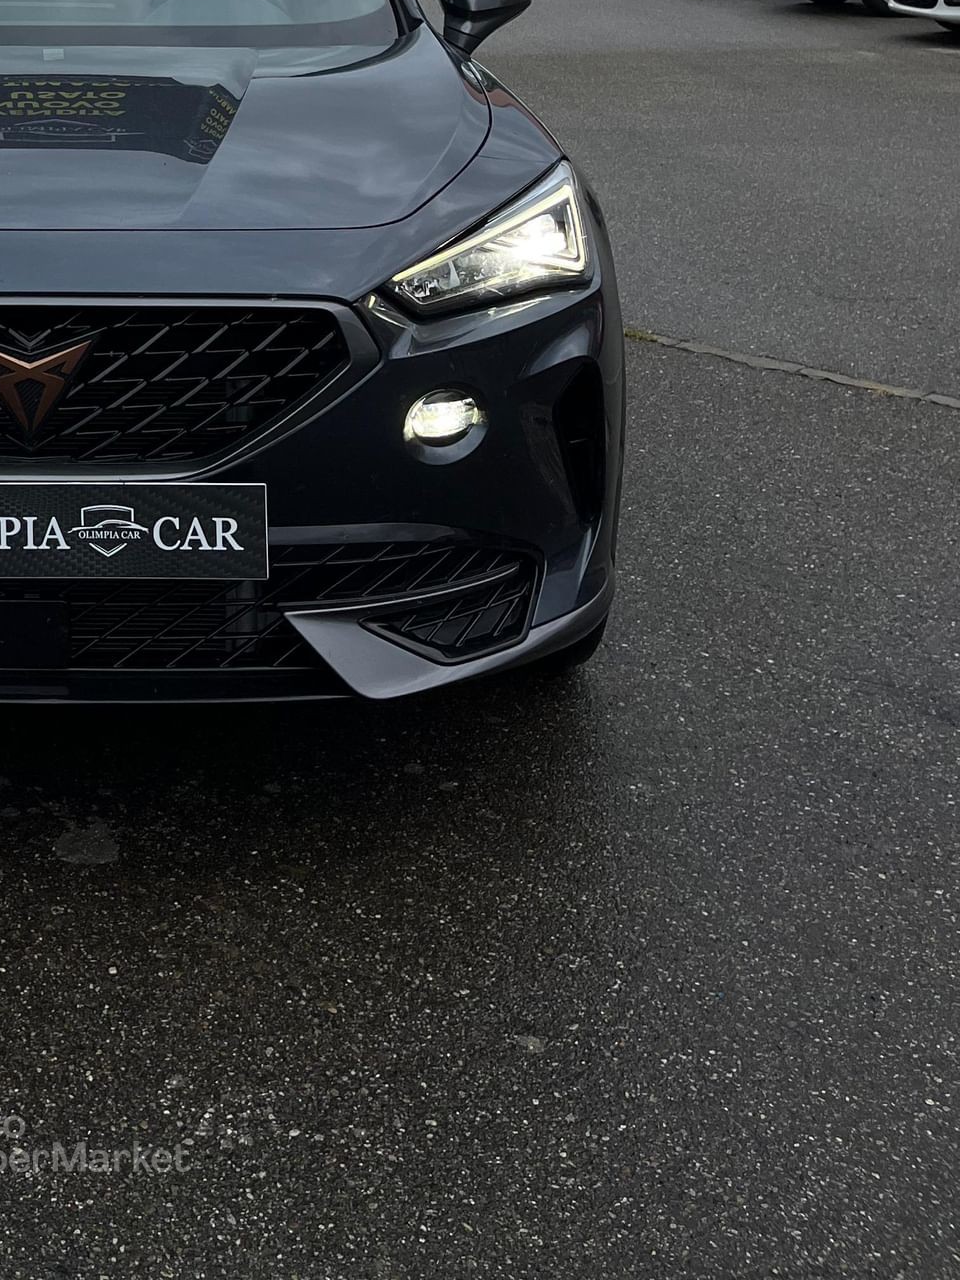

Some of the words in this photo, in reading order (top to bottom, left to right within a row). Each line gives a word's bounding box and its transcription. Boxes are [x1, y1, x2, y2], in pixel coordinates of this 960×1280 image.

[78, 530, 120, 540] OLIMPIA
[121, 530, 141, 540] CAR
[152, 516, 244, 551] CAR
